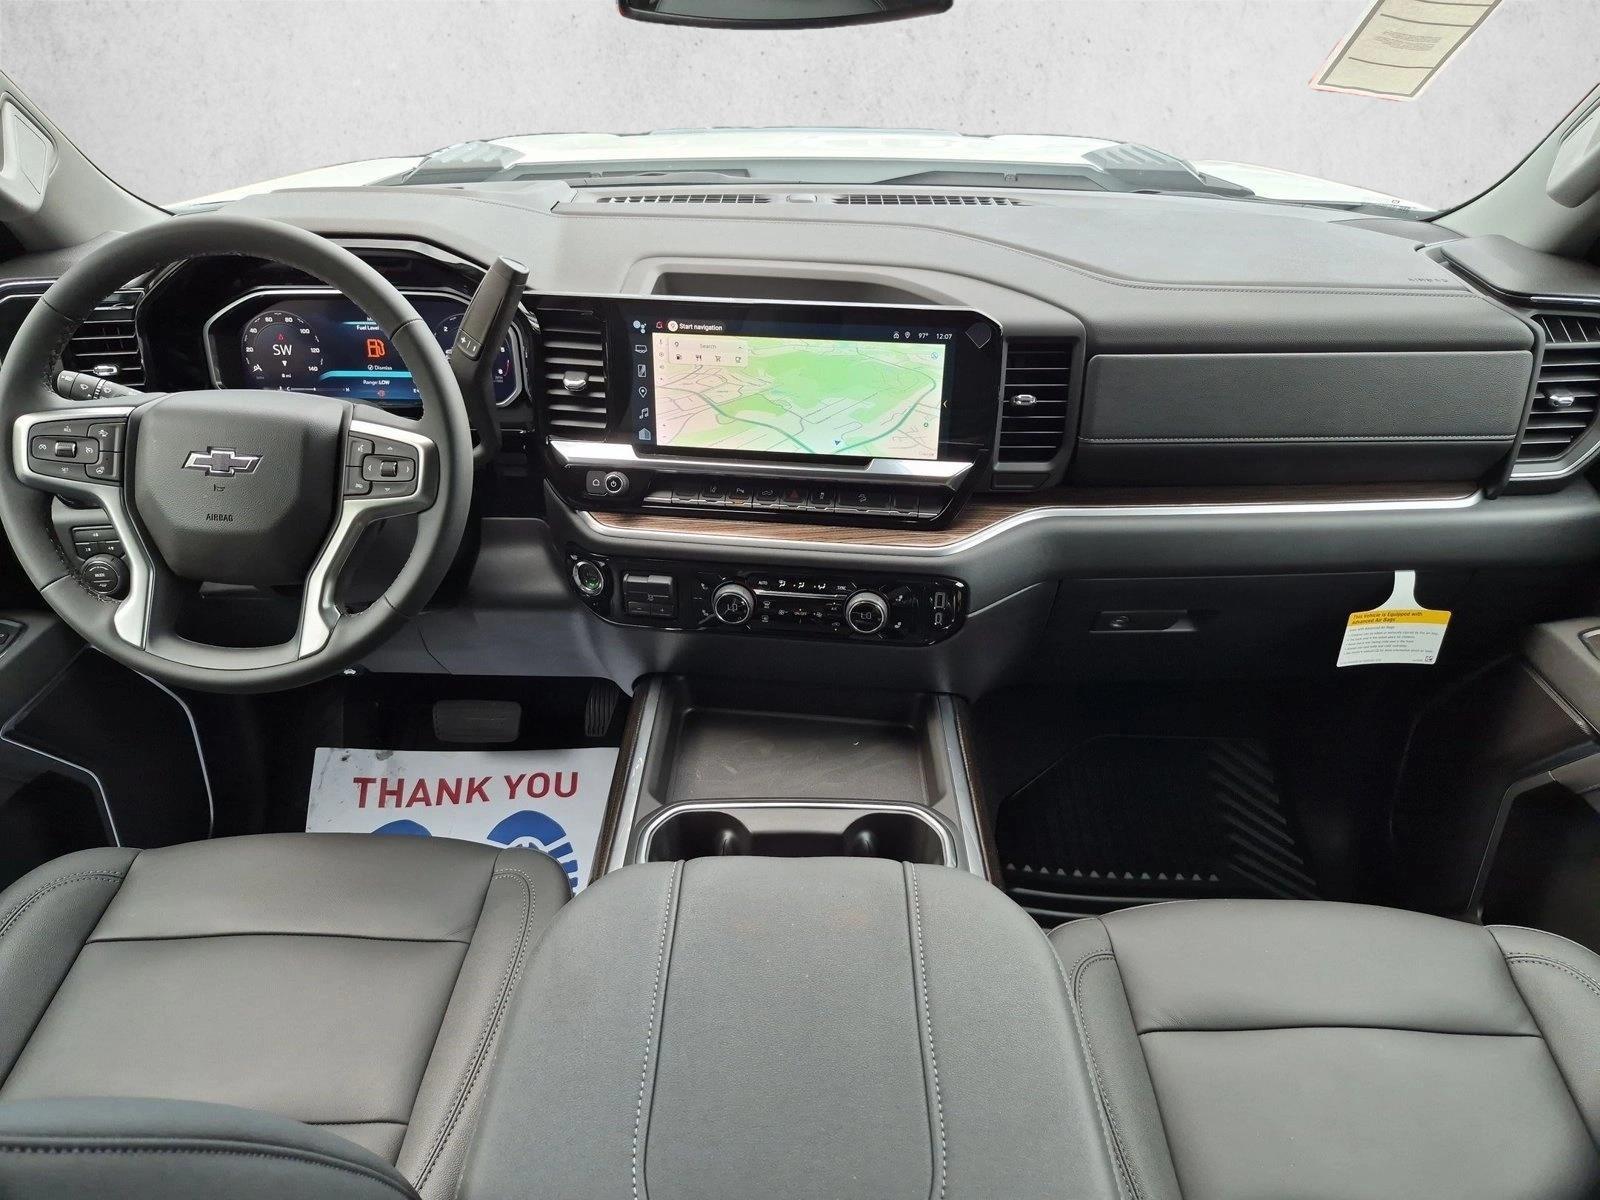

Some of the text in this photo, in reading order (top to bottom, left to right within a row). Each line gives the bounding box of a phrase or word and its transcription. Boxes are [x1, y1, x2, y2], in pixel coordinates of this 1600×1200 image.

[272, 344, 292, 356] SW
[206, 514, 234, 522] AIRBAG
[353, 772, 579, 808] THANK YOU
